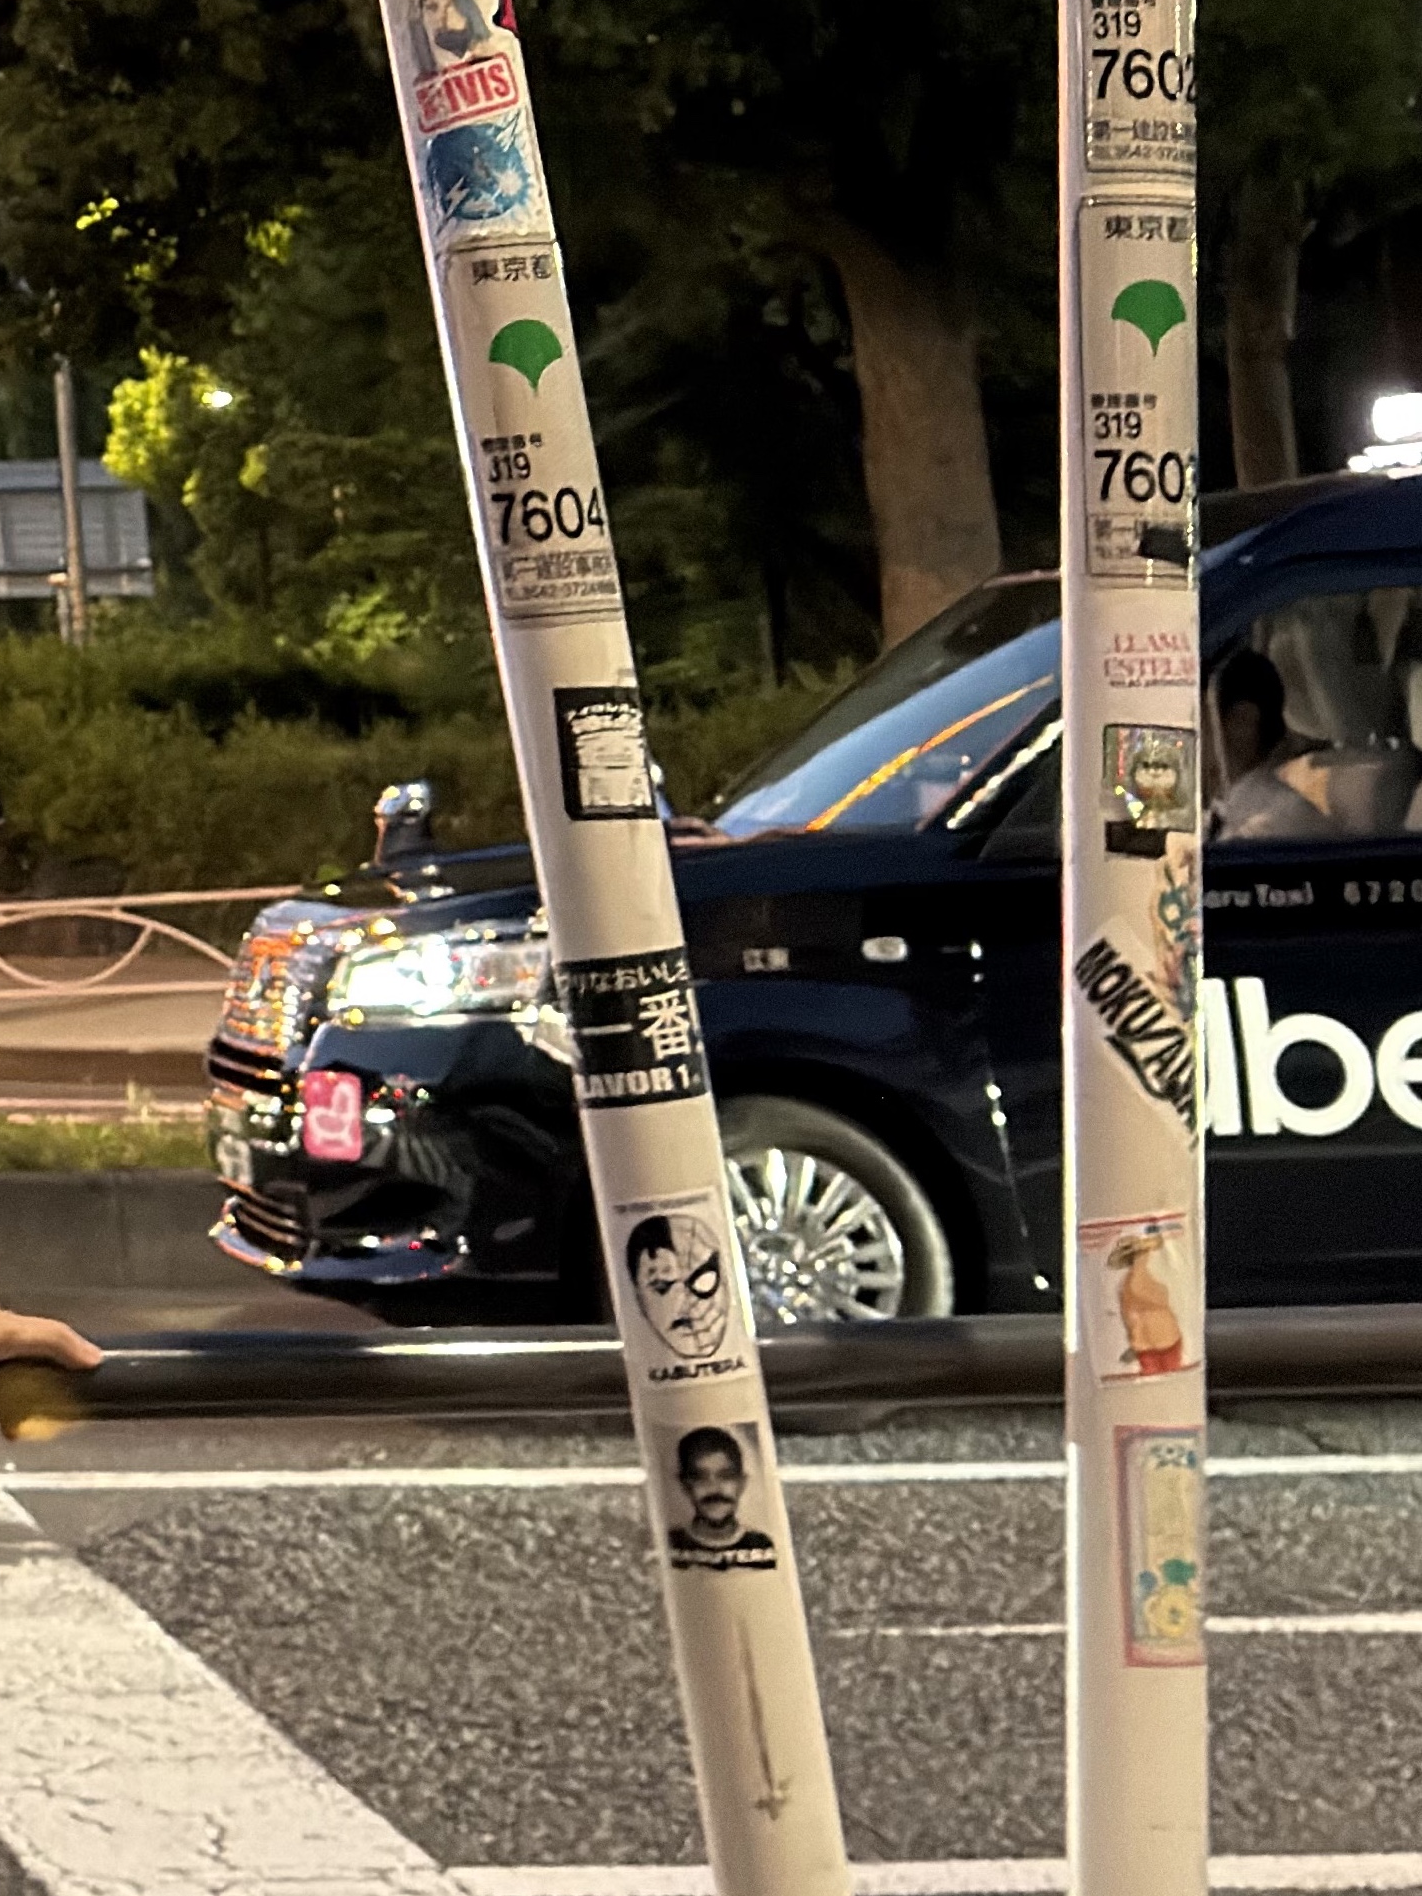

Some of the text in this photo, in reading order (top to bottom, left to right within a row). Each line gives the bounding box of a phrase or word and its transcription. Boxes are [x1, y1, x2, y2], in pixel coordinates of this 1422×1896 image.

[1093, 10, 1142, 39] 319
[1094, 411, 1142, 440] 319
[1094, 450, 1197, 503] 760
[491, 487, 604, 546] 7604
